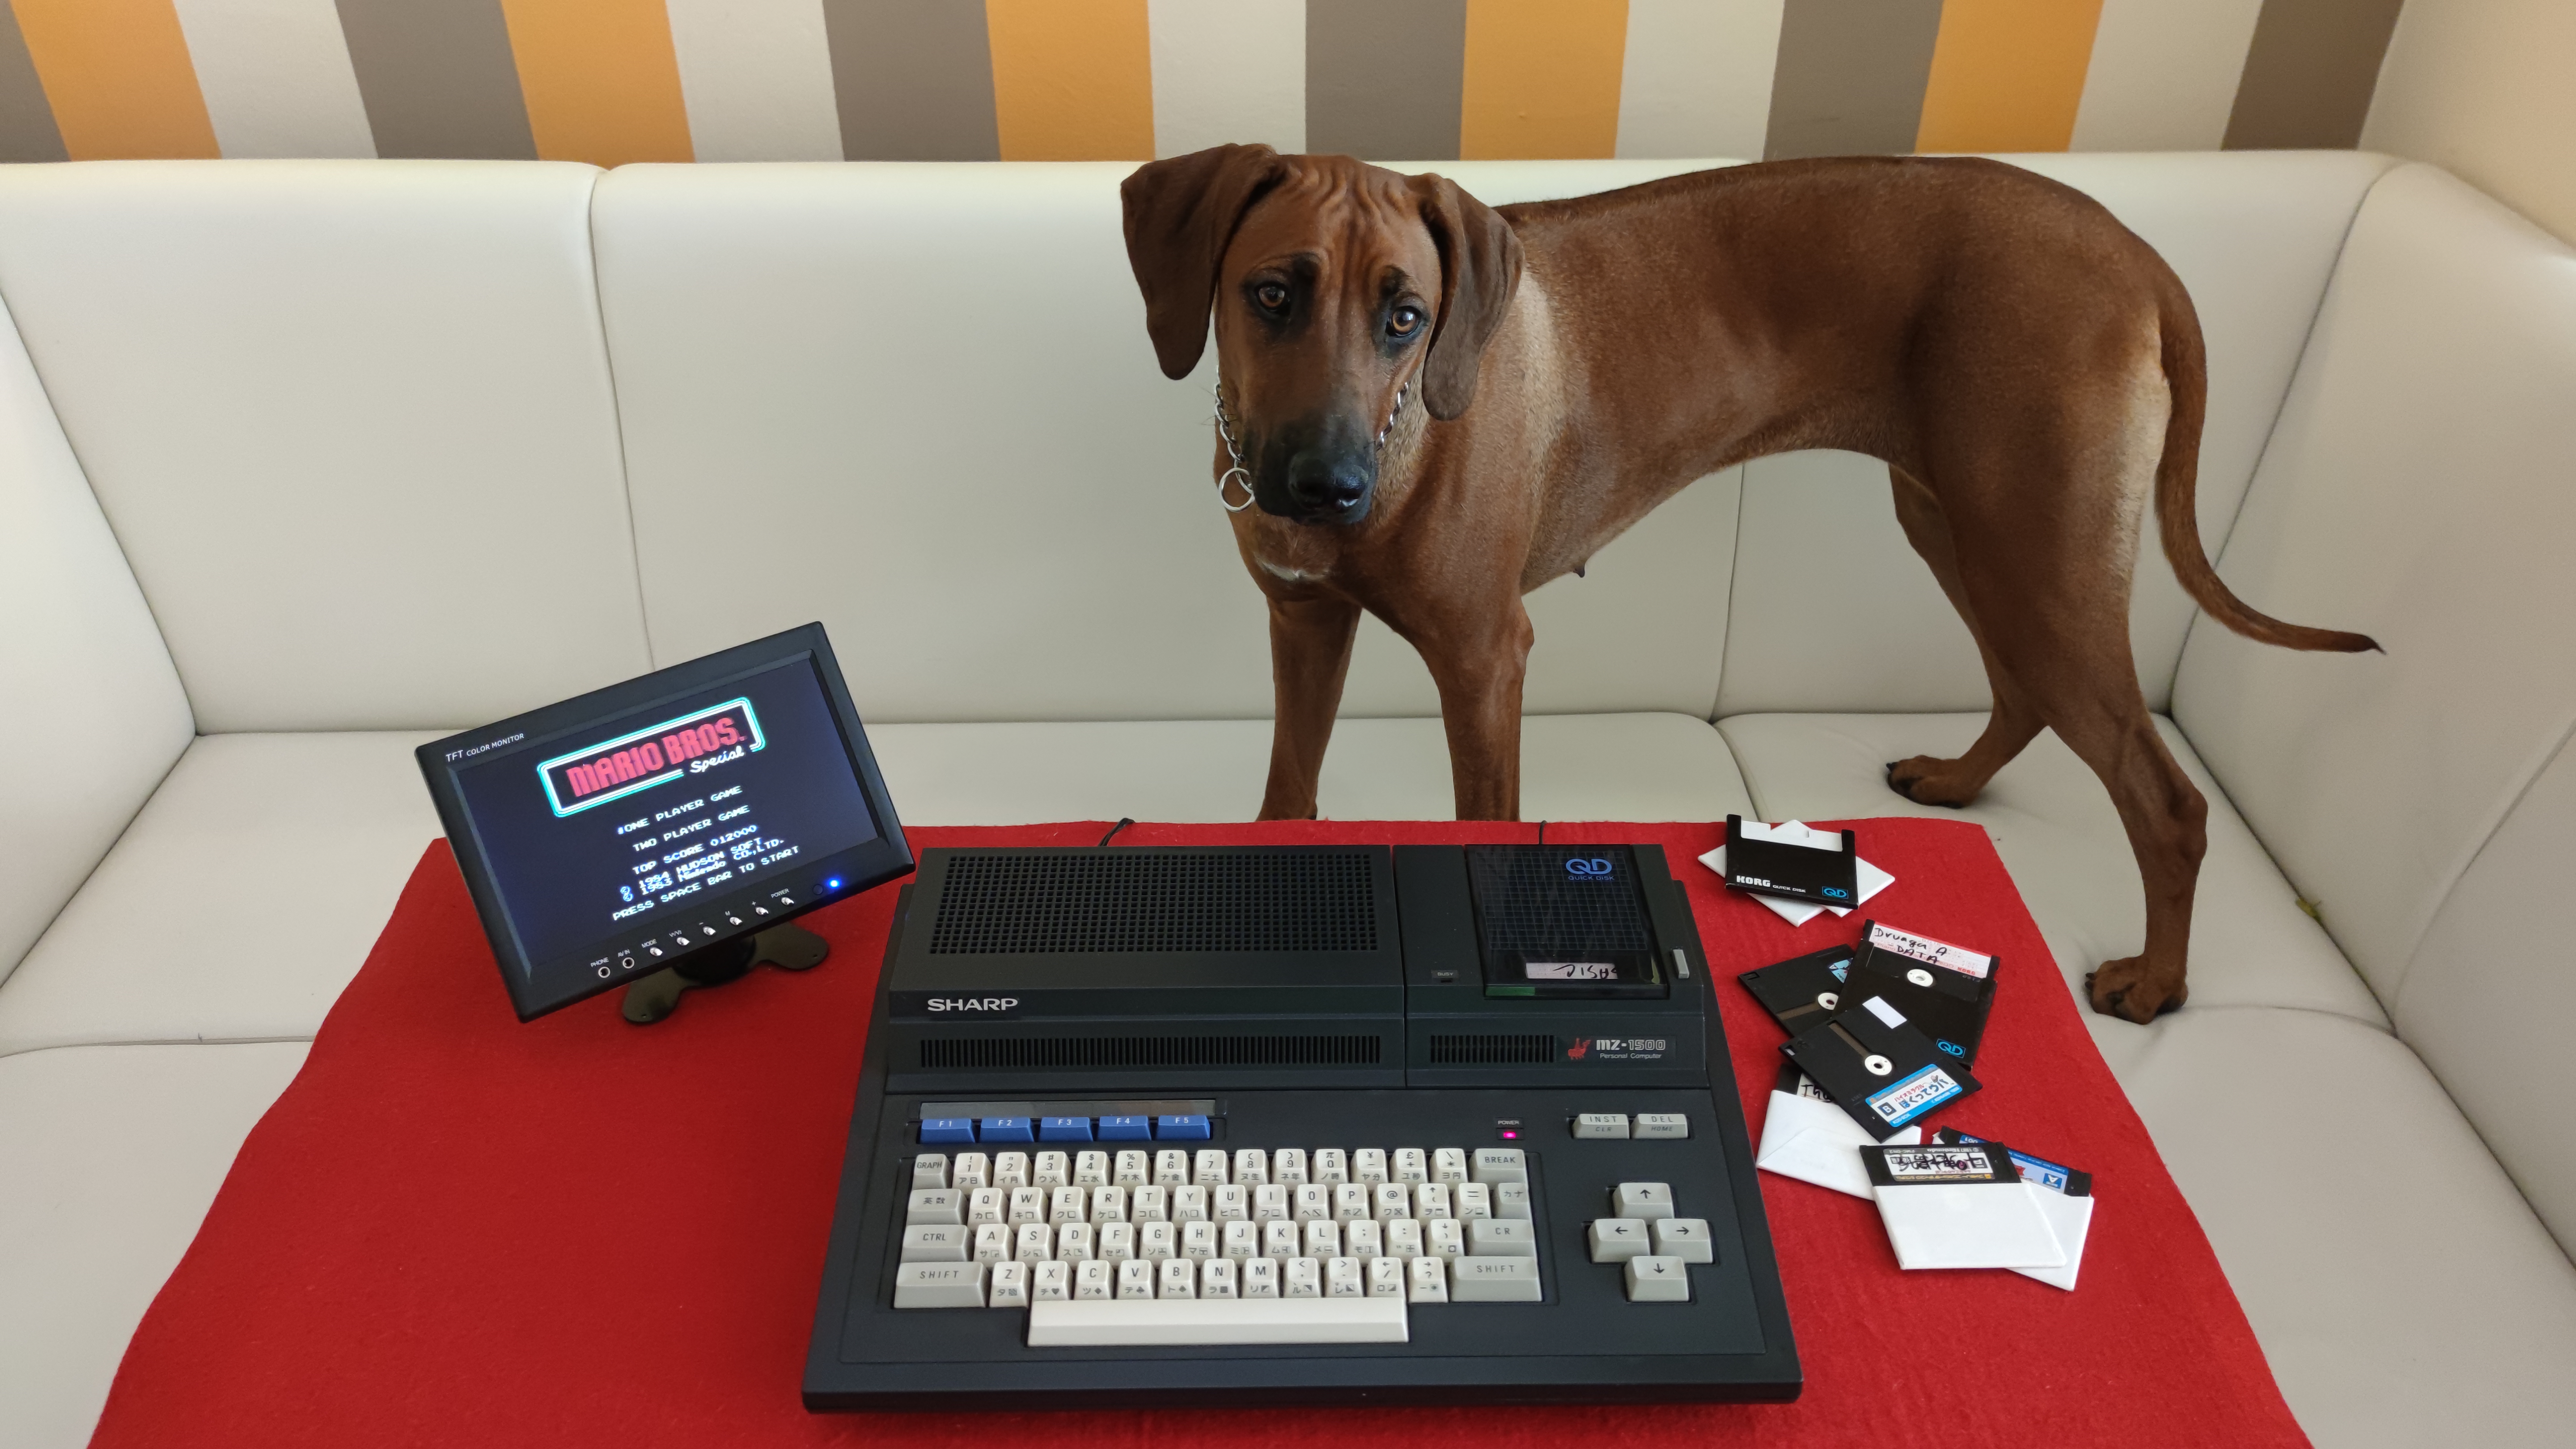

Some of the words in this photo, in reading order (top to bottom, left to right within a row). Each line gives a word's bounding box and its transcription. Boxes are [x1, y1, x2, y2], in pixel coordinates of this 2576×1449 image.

[446, 750, 463, 762] TFT
[466, 745, 490, 756] COLOR
[492, 733, 524, 749] MONITOR
[566, 743, 664, 797] MARIO
[661, 717, 746, 764] BROS.
[690, 745, 745, 773] Special
[656, 799, 704, 821] PLAYER
[711, 786, 742, 801] GAME
[633, 838, 657, 852] TWO
[664, 819, 712, 841] PLAYER
[718, 805, 750, 821] GAME
[633, 860, 657, 875] TOP
[664, 843, 706, 864] SCORE
[710, 825, 757, 846] 012000
[639, 871, 669, 888] 1984
[676, 852, 724, 874] HUDSON
[730, 837, 762, 852] SOFT
[1566, 859, 1612, 874] QD
[642, 878, 673, 895] 1983
[678, 860, 725, 882] Nintendo
[613, 900, 654, 920] PRESS
[661, 882, 701, 902] SPACE
[707, 871, 733, 885] BAR
[739, 863, 754, 873] TO
[761, 846, 799, 865] START
[1737, 875, 1771, 887] KORG
[1824, 888, 1847, 898] QD
[771, 889, 789, 898] POWER
[642, 939, 657, 948] MODE
[1936, 947, 1947, 956] A
[590, 957, 609, 967] PHONE
[927, 999, 1018, 1011] SHARP
[1938, 1042, 1963, 1055] QD
[917, 1161, 942, 1169] GRAPH
[1127, 1161, 1133, 1169] 5
[2048, 1175, 2059, 1183] A
[983, 1195, 989, 1204] Q
[1021, 1194, 1032, 1203] W
[1064, 1194, 1071, 1203] E
[1105, 1194, 1112, 1203] R
[1146, 1193, 1153, 1202] T
[1186, 1193, 1193, 1201] Y
[1227, 1191, 1233, 1200] U
[987, 1231, 995, 1240] A
[1030, 1231, 1037, 1240] S
[1072, 1230, 1078, 1239] D
[1114, 1230, 1120, 1239] F
[1155, 1229, 1161, 1239] G
[1196, 1229, 1203, 1238] H
[1237, 1228, 1244, 1237] J
[1278, 1228, 1285, 1237] K
[1320, 1228, 1326, 1237] L
[920, 1271, 959, 1279] SHIFT
[1005, 1269, 1012, 1279] Z
[1046, 1268, 1055, 1278] X
[1089, 1268, 1096, 1278] C
[1131, 1267, 1139, 1277] V
[1174, 1267, 1179, 1276] B
[1216, 1267, 1223, 1276] N
[1256, 1266, 1266, 1275] M
